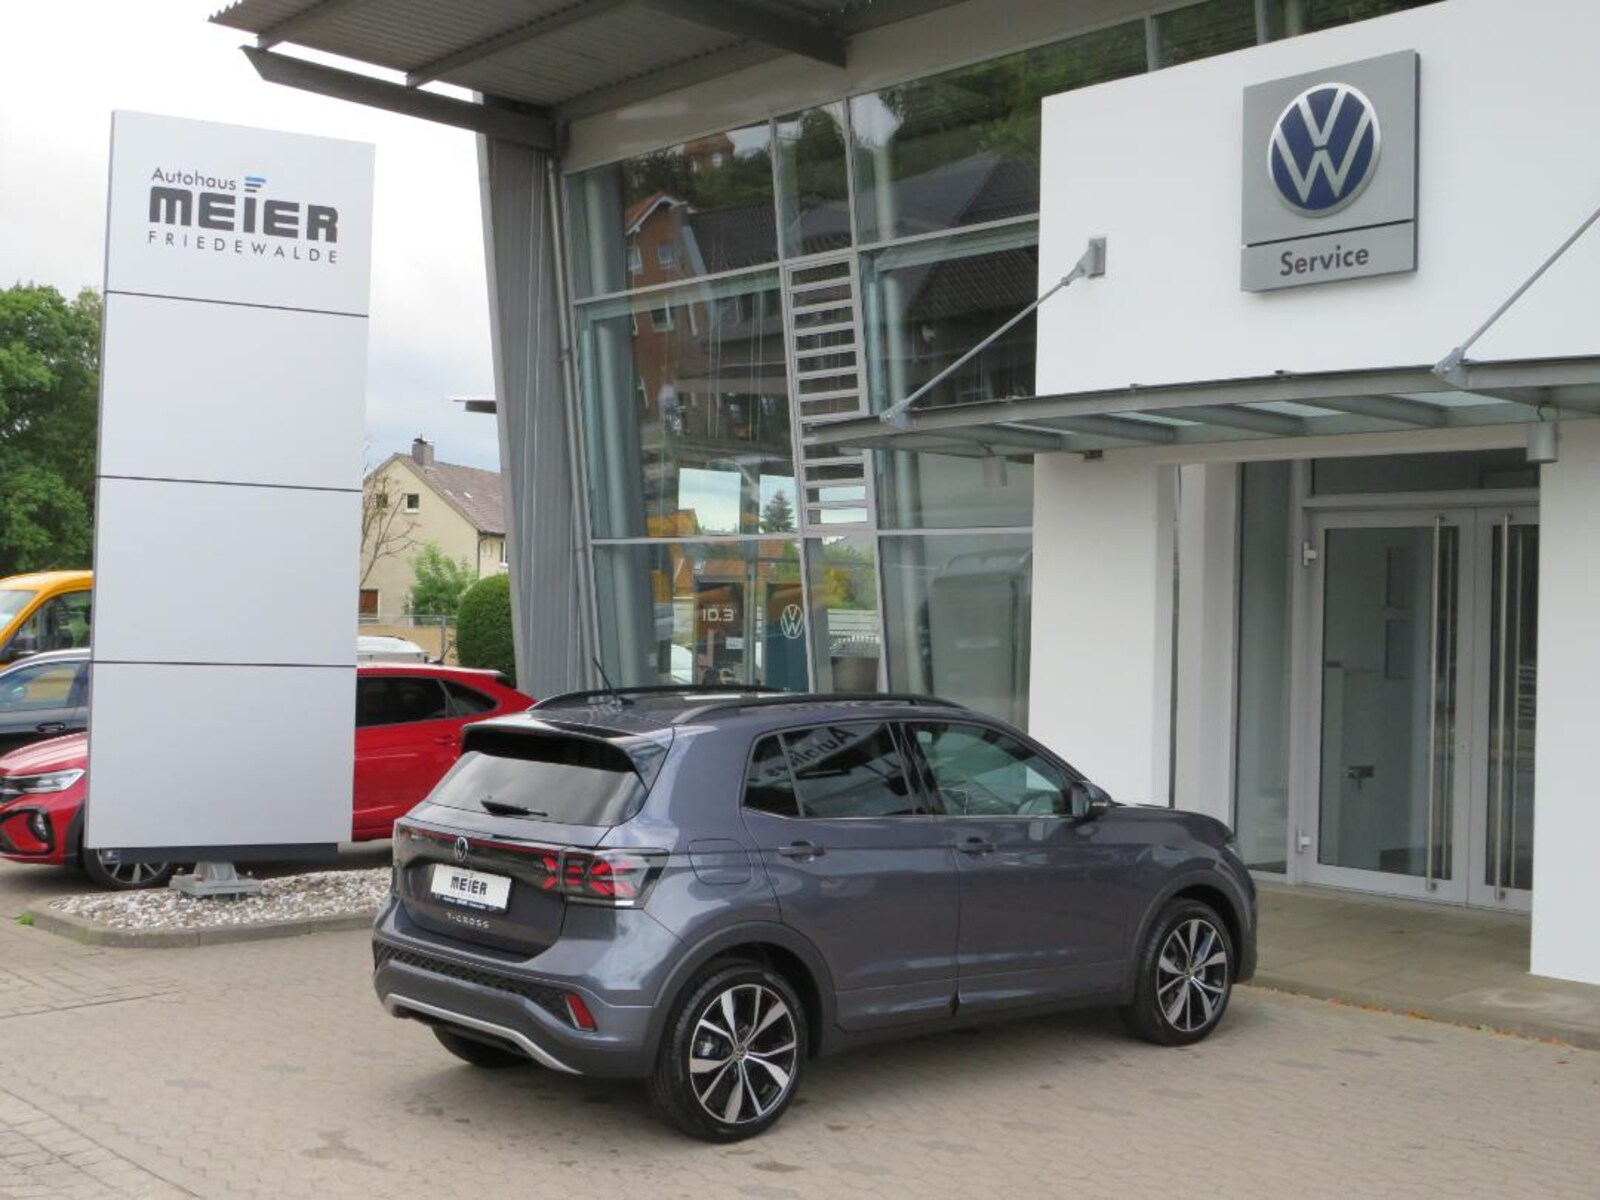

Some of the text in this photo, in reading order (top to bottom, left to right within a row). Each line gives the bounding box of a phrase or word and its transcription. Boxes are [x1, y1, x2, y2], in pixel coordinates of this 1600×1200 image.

[151, 167, 236, 190] Autohaus
[149, 185, 338, 243] MEIER
[148, 231, 337, 263] FRIEDEWALDE
[1280, 245, 1369, 276] Service
[450, 876, 488, 896] MEIER
